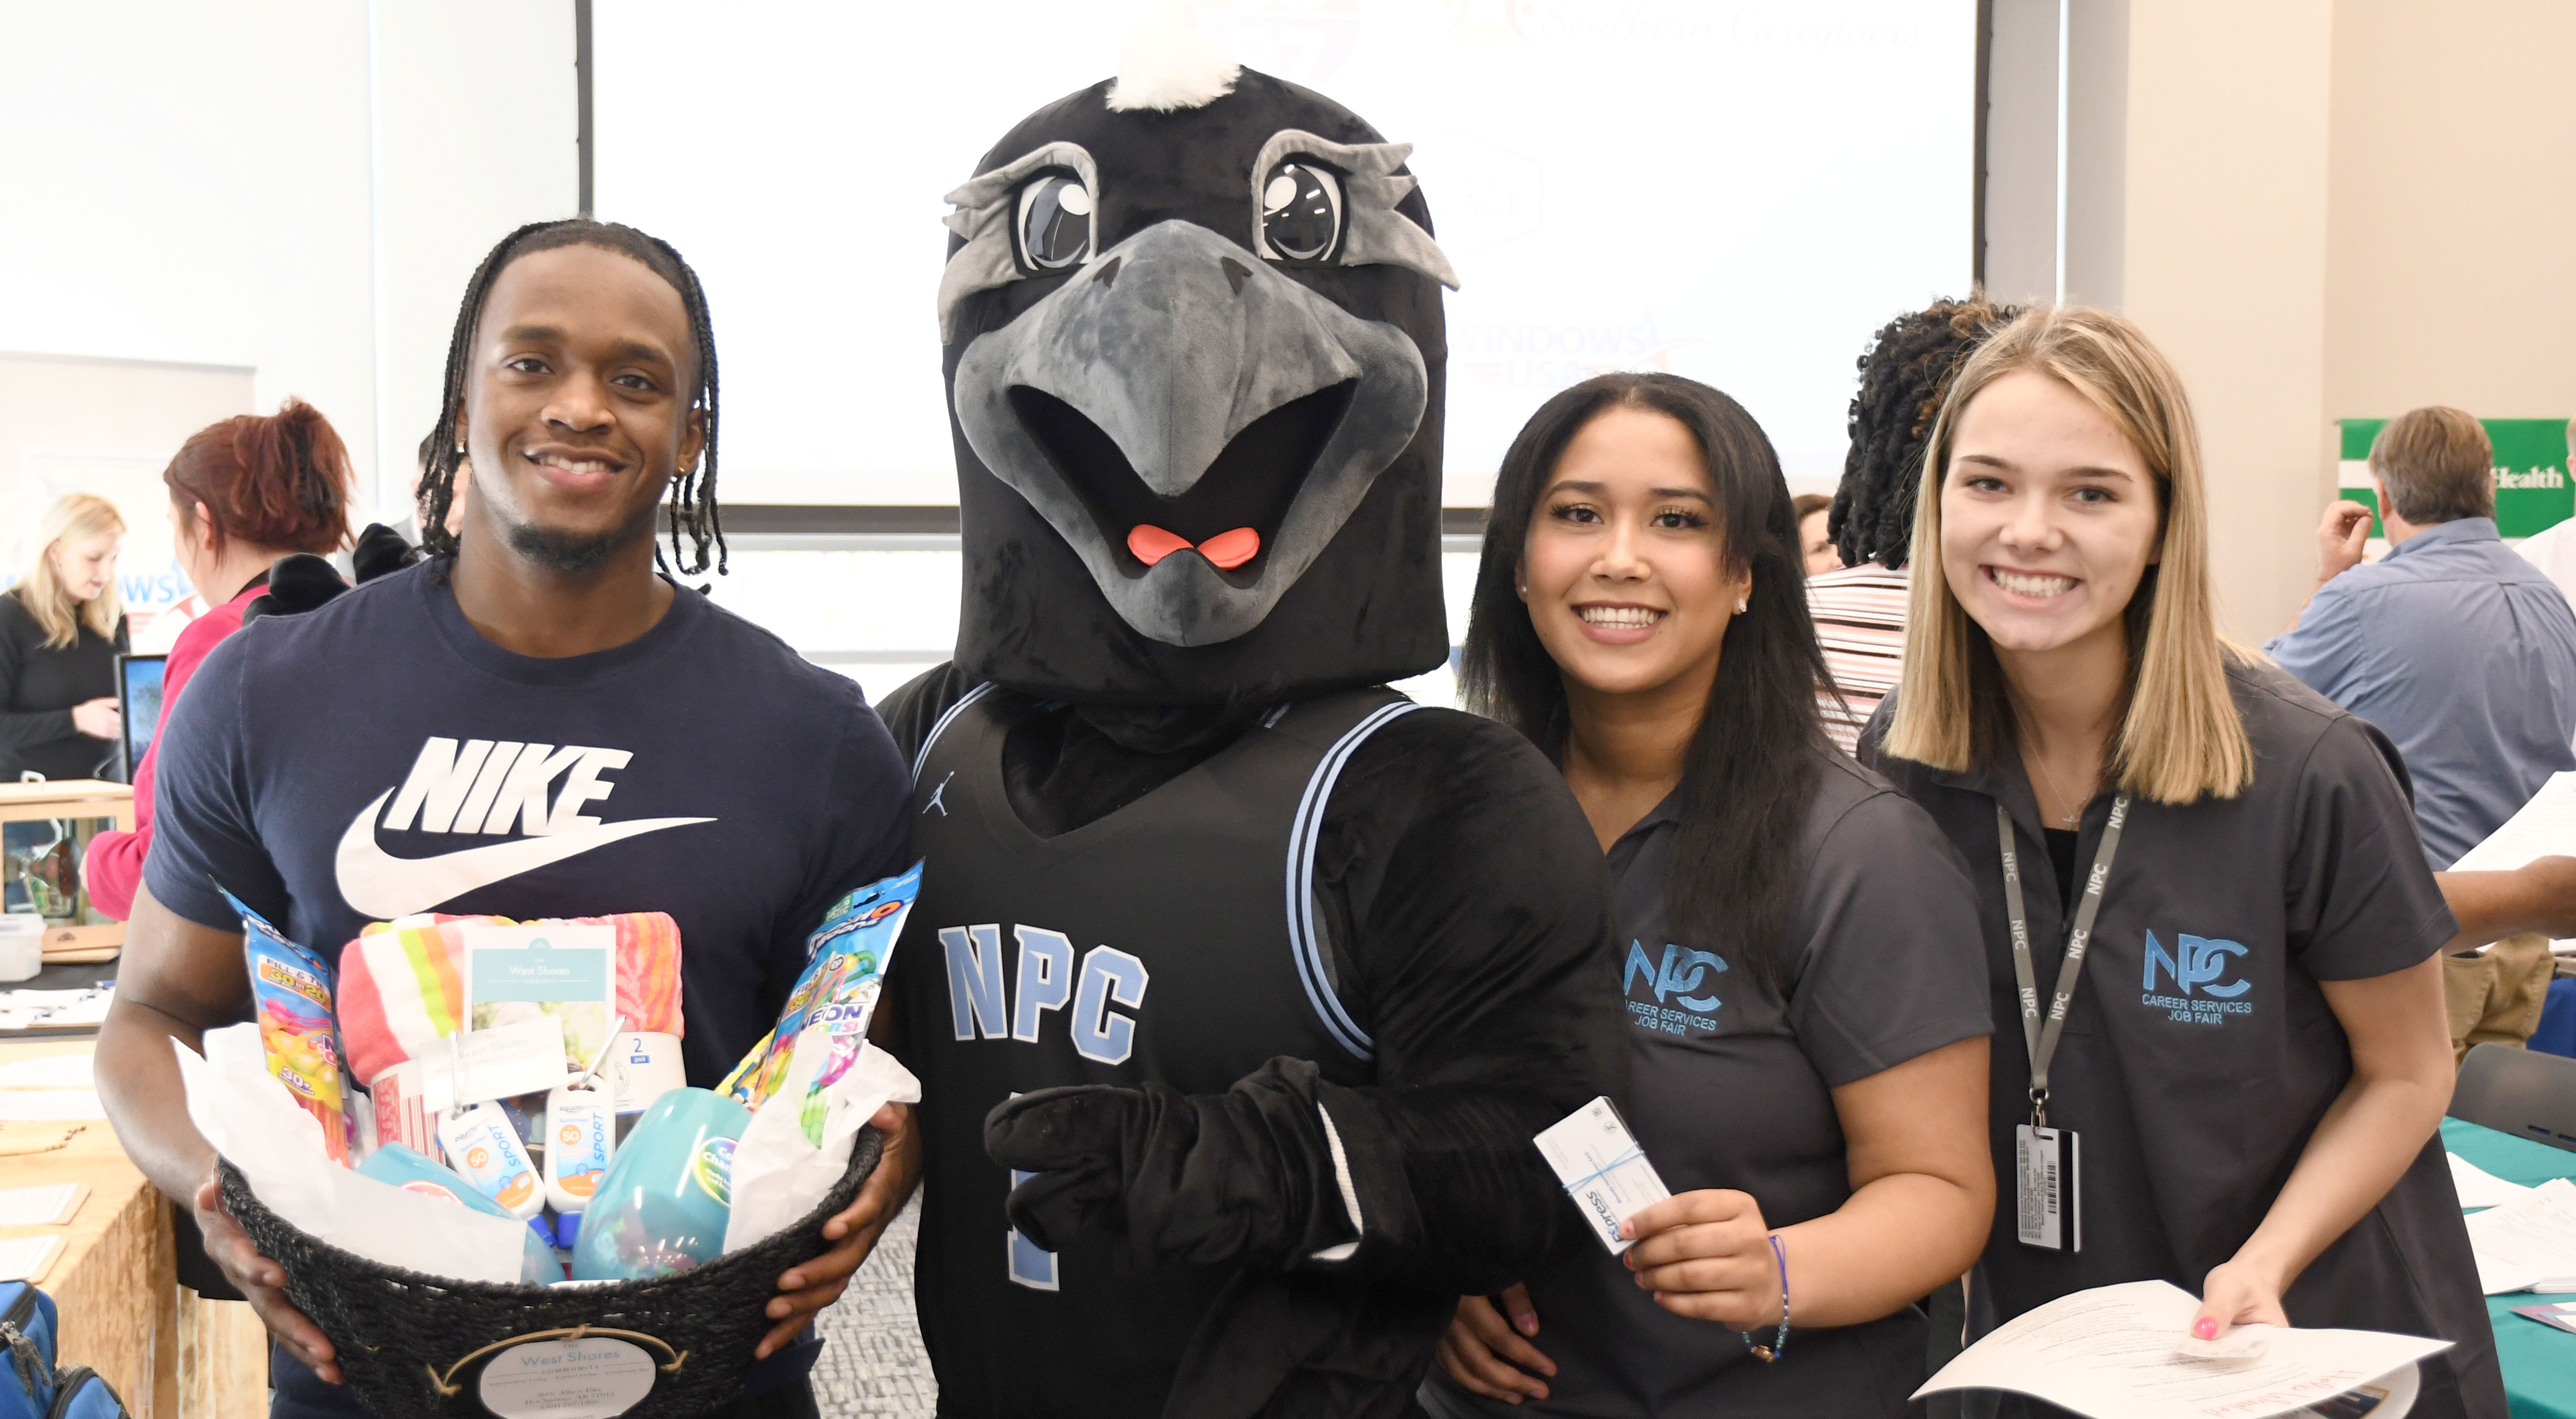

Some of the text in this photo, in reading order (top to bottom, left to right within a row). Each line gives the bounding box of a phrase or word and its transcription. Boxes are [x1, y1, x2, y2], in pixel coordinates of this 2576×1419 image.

[1449, 324, 1646, 356] WINDOWS
[383, 736, 633, 836] NIKE
[2108, 796, 2128, 828] NPC
[2003, 852, 2016, 882] NPC
[2087, 863, 2107, 895] NPC
[2012, 919, 2026, 950] NPC
[2068, 929, 2087, 959] NPC
[266, 958, 293, 975] FILL
[296, 971, 305, 980] &
[510, 965, 570, 975] West Shores
[1623, 938, 1729, 1012] NPC
[2142, 928, 2252, 998] NPC
[269, 967, 295, 987] 30
[296, 981, 305, 991] in
[305, 985, 327, 1006] 20
[938, 923, 1149, 1066] NPC
[2021, 987, 2037, 1018] NPC
[2050, 991, 2069, 1020] NPC
[2142, 993, 2252, 1014] CAREER SERVICES
[1635, 1016, 1687, 1036] JOB FAIR
[1660, 1008, 1717, 1031] SERVICES
[2167, 1011, 2222, 1024] JOB FAIR
[490, 1039, 528, 1052] Shores
[633, 1038, 643, 1053] 2
[281, 1066, 312, 1090] 30+
[455, 1126, 478, 1142] equate
[460, 1135, 488, 1152] Sunscreen
[487, 1124, 521, 1167] SPORT
[562, 1131, 579, 1141] 50
[593, 1111, 604, 1162] SPORT
[470, 1151, 487, 1167] 50
[520, 1350, 621, 1366] West Shores
[541, 1365, 599, 1374] COMMUNITY
